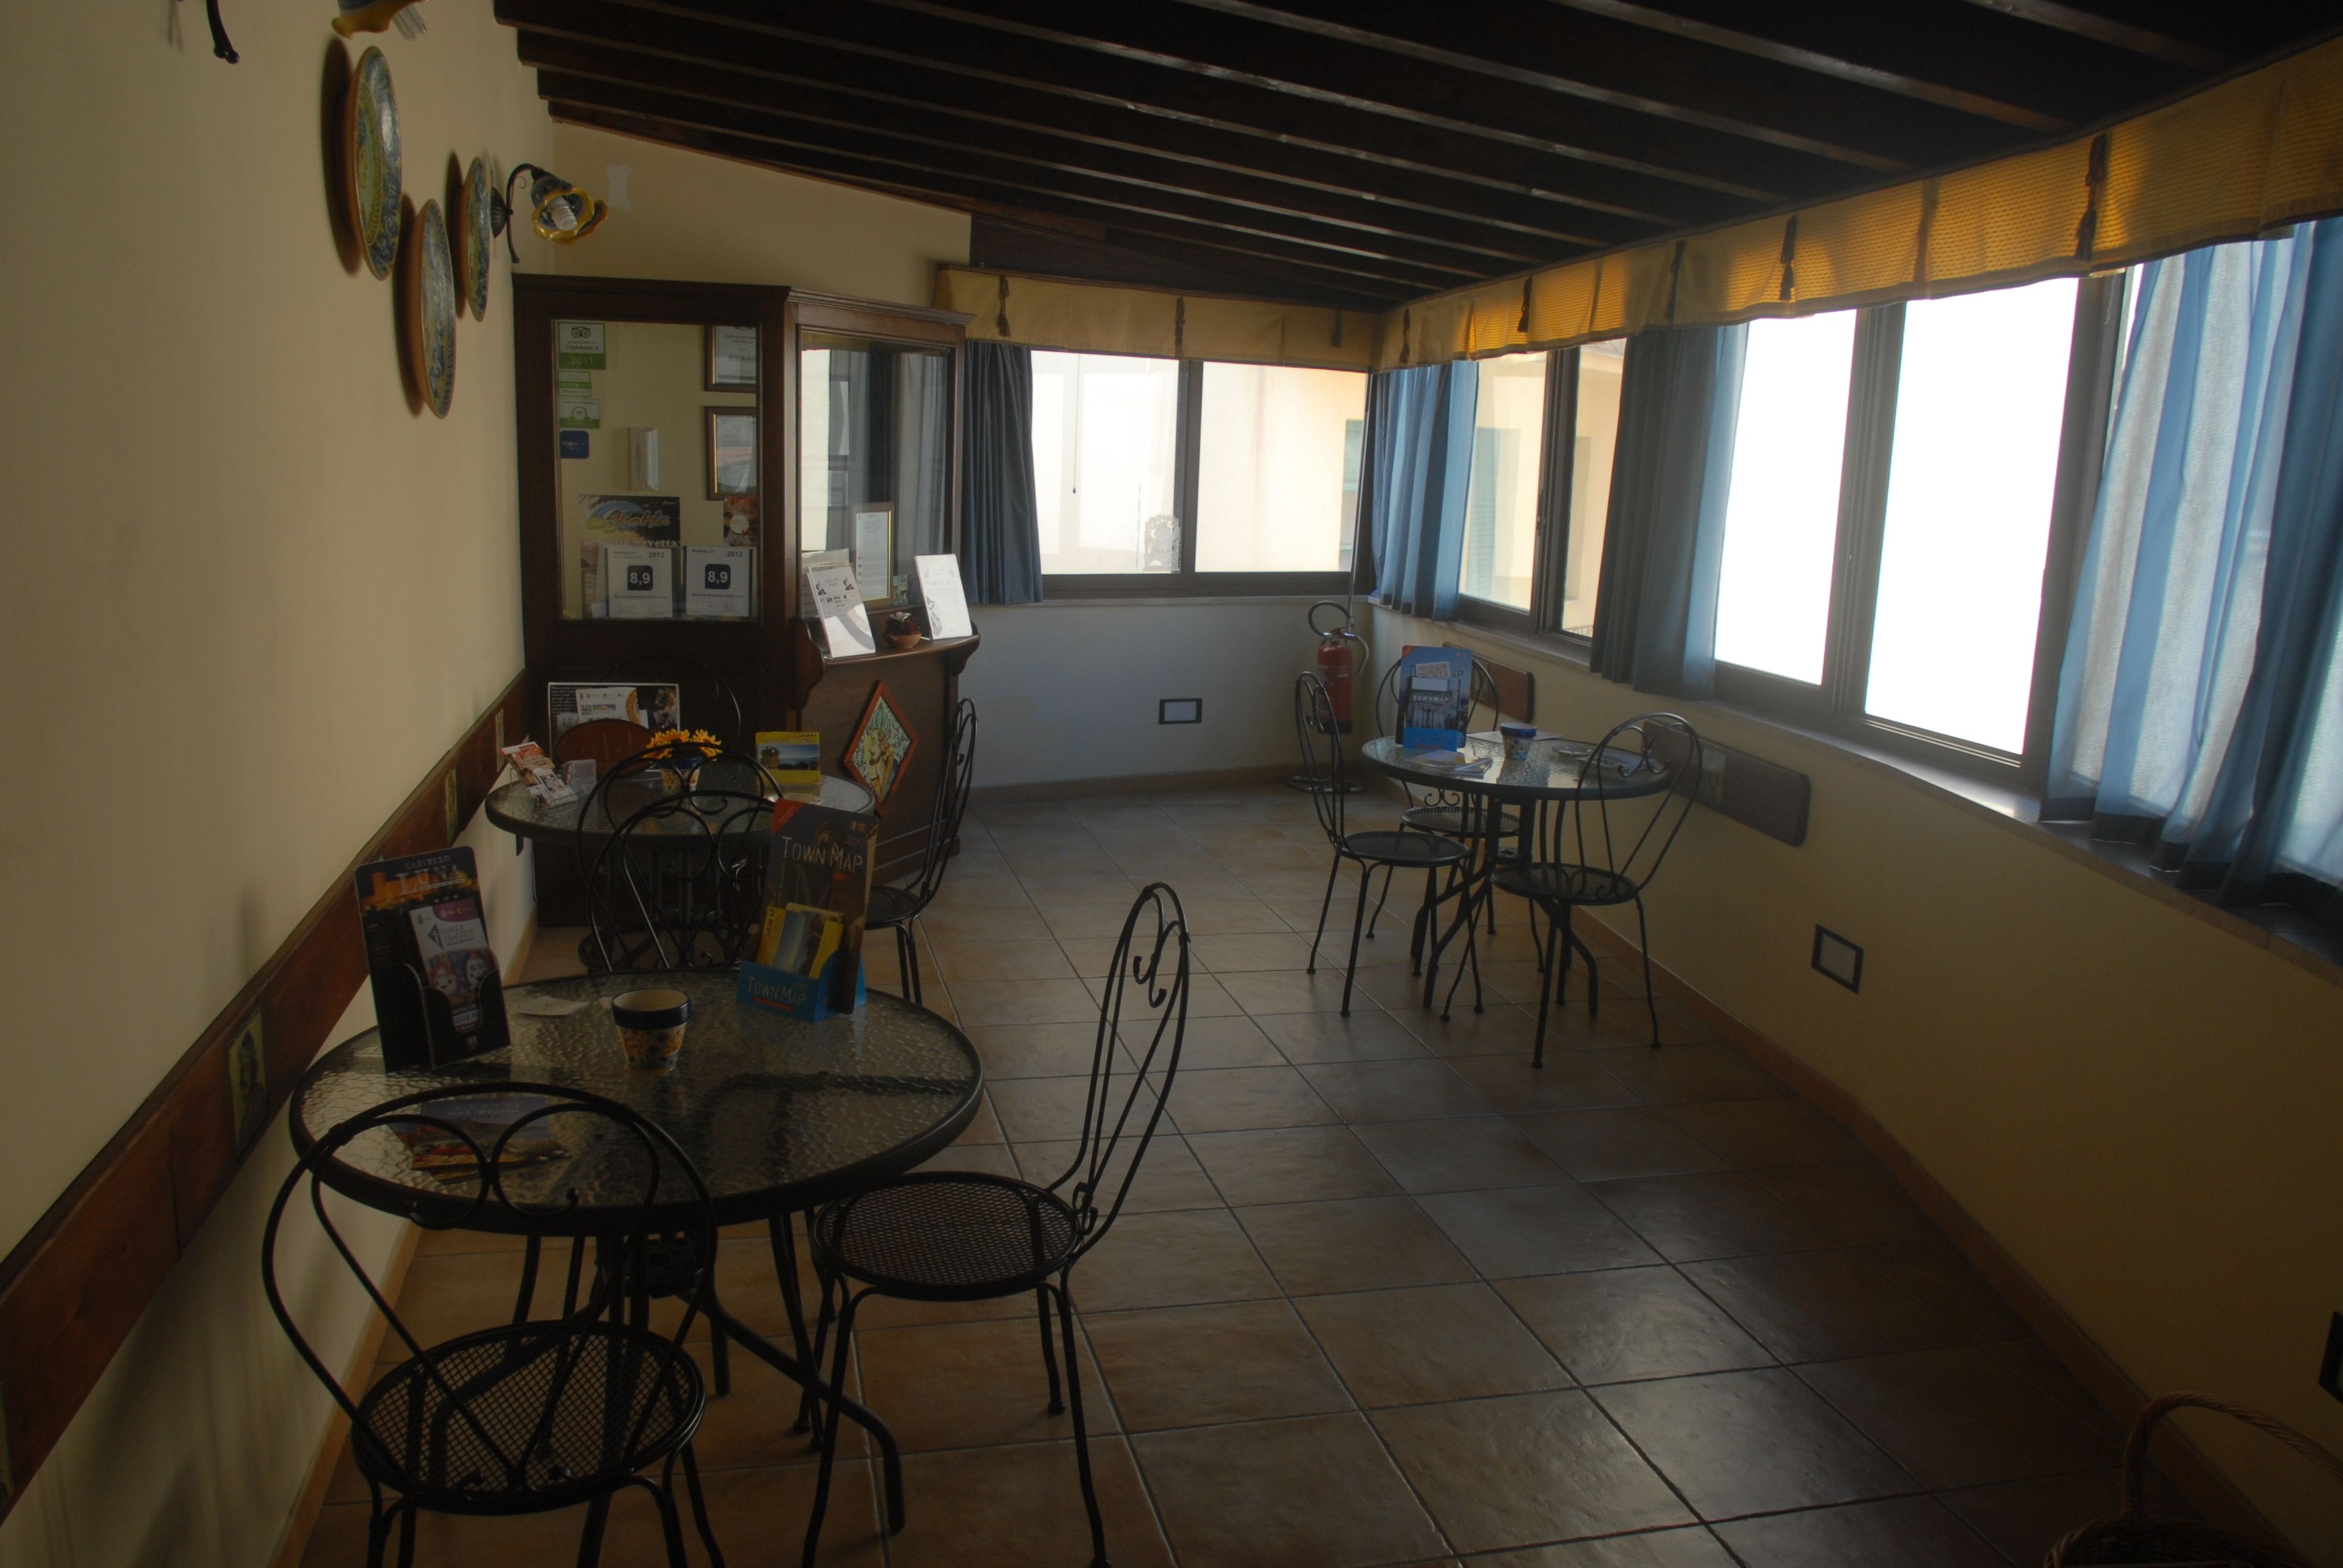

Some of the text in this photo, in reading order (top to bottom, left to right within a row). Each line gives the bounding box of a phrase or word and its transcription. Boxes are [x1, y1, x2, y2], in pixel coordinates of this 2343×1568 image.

[570, 356, 594, 365] 2011
[630, 572, 651, 586] 8,9
[708, 570, 729, 585] 8,9
[1413, 694, 1450, 703] TOWNMAP
[404, 854, 451, 869] CASTELLO
[781, 836, 863, 873] TOWN MAP
[394, 863, 459, 896] LUNA
[747, 976, 779, 1000] TOWN
[780, 985, 807, 1005] MAP
